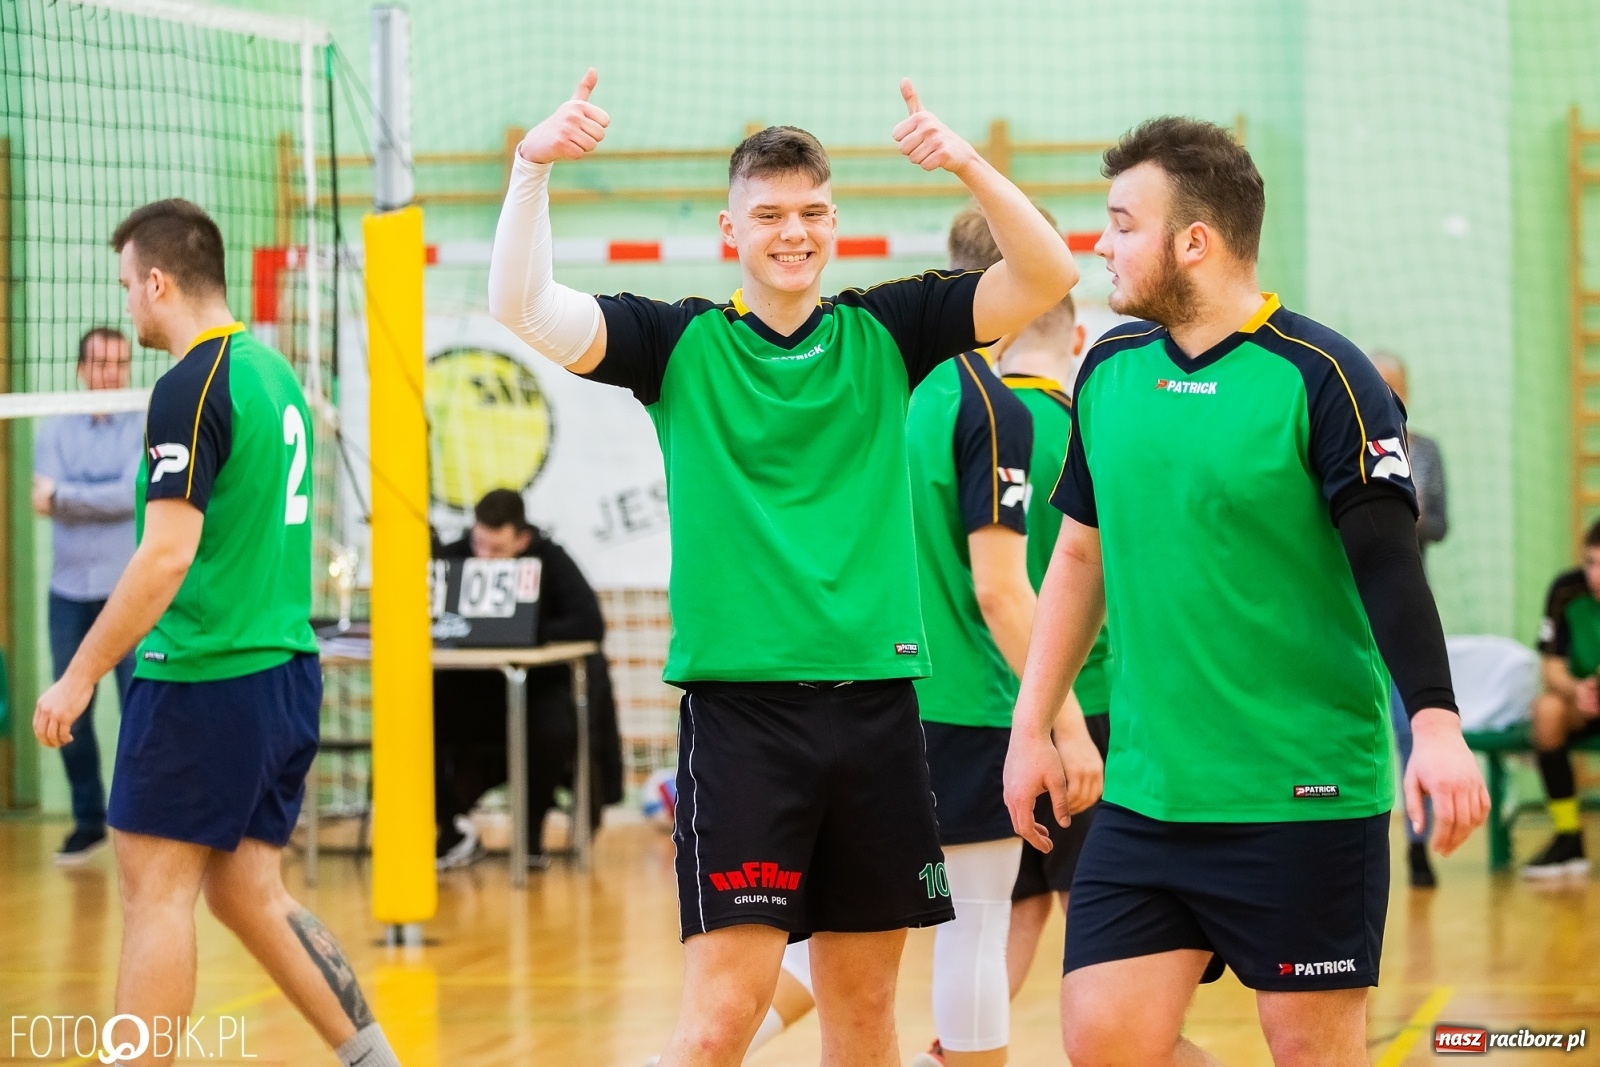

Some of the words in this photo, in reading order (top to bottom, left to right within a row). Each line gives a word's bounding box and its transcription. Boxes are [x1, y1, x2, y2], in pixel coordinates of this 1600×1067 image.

[1166, 379, 1218, 395] PATRICK
[282, 403, 309, 526] 2
[464, 566, 514, 608] 05
[918, 861, 950, 899] 10
[734, 894, 769, 905] GRUPA
[771, 895, 787, 906] PBG
[1294, 958, 1357, 976] PATRICK
